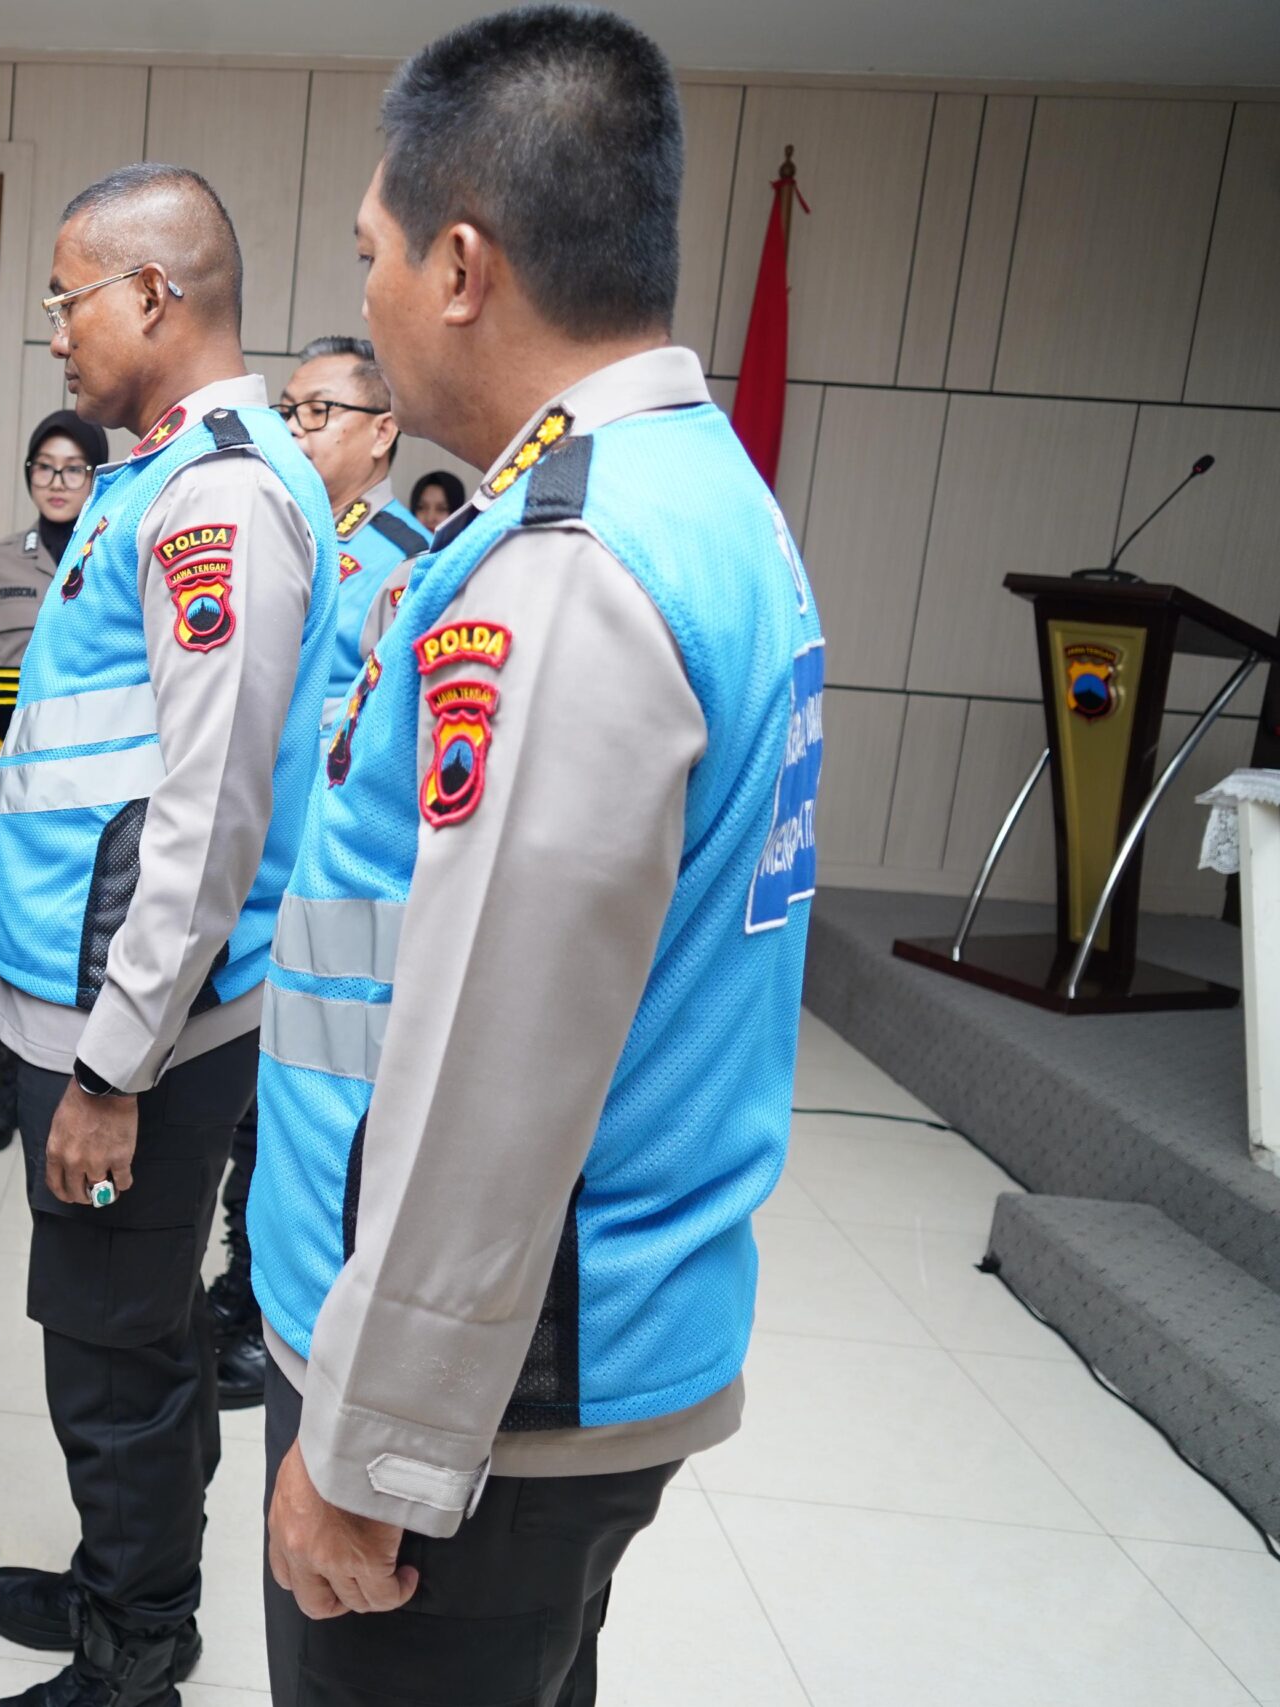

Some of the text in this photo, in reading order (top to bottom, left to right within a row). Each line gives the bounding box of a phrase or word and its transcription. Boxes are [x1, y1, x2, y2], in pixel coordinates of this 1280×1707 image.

[162, 527, 227, 560] POLDA
[173, 563, 226, 583] JAWA TENGAH
[423, 626, 505, 666] POLDA
